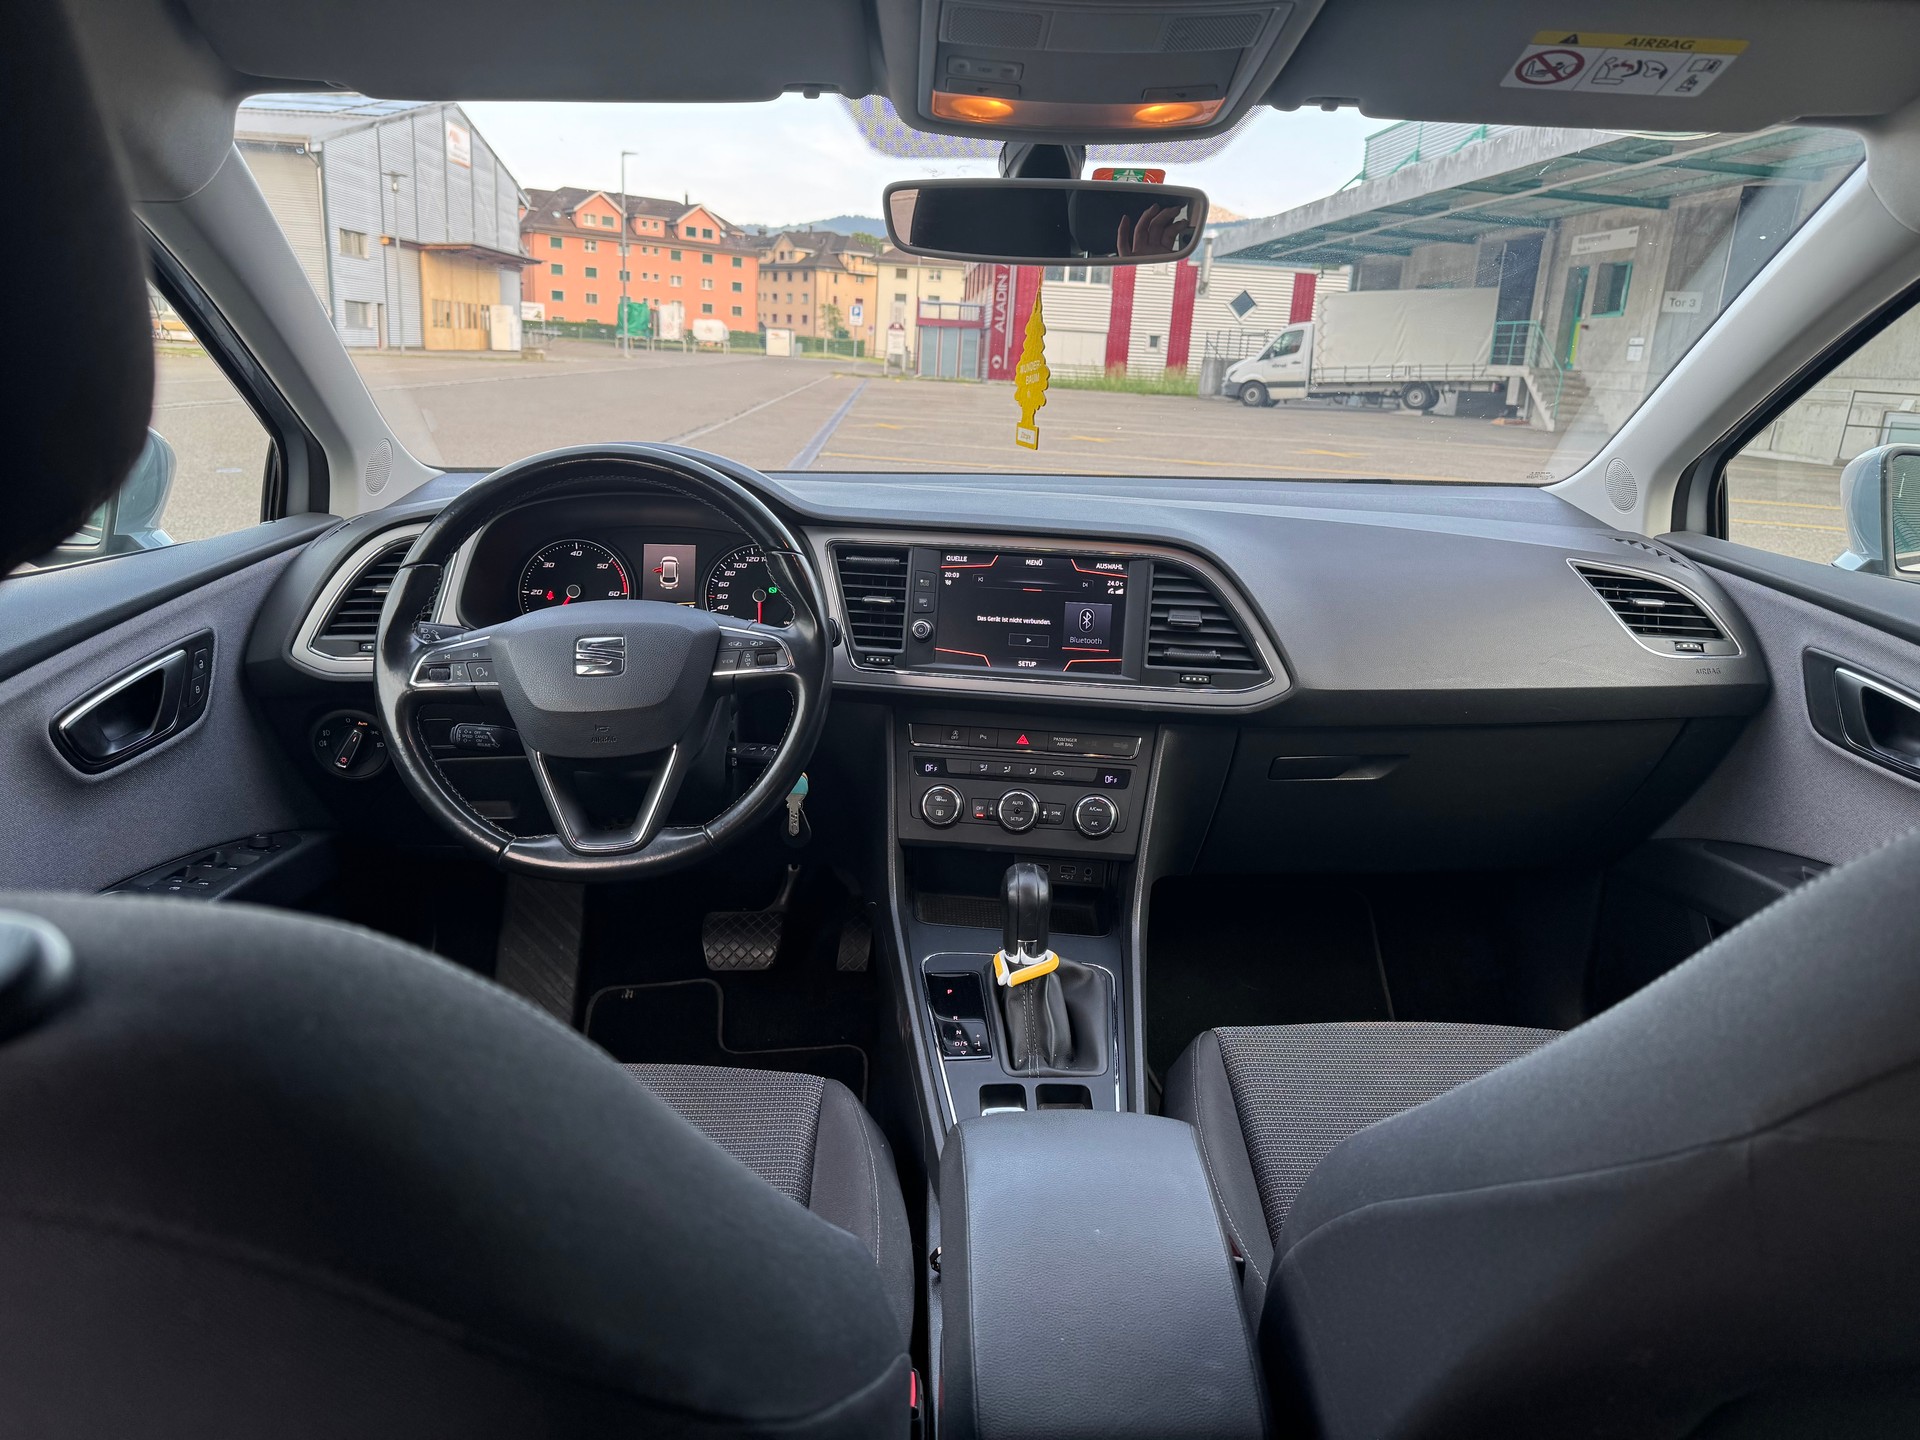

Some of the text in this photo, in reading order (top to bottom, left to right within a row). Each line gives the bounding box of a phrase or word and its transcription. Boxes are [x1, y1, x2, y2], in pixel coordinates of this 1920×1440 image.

[1624, 37, 1695, 50] AIRBAG
[995, 273, 1008, 334] ALADIN
[1669, 297, 1696, 307] Tor 3
[1026, 373, 1040, 385] BAUM
[1025, 558, 1043, 566] MENÜ
[1096, 562, 1124, 570] AUSWAHL
[987, 615, 1001, 623] Gerät
[1069, 636, 1103, 644] Bluetooth
[1018, 660, 1037, 668] SETUP
[1695, 667, 1721, 675] AIRBAG
